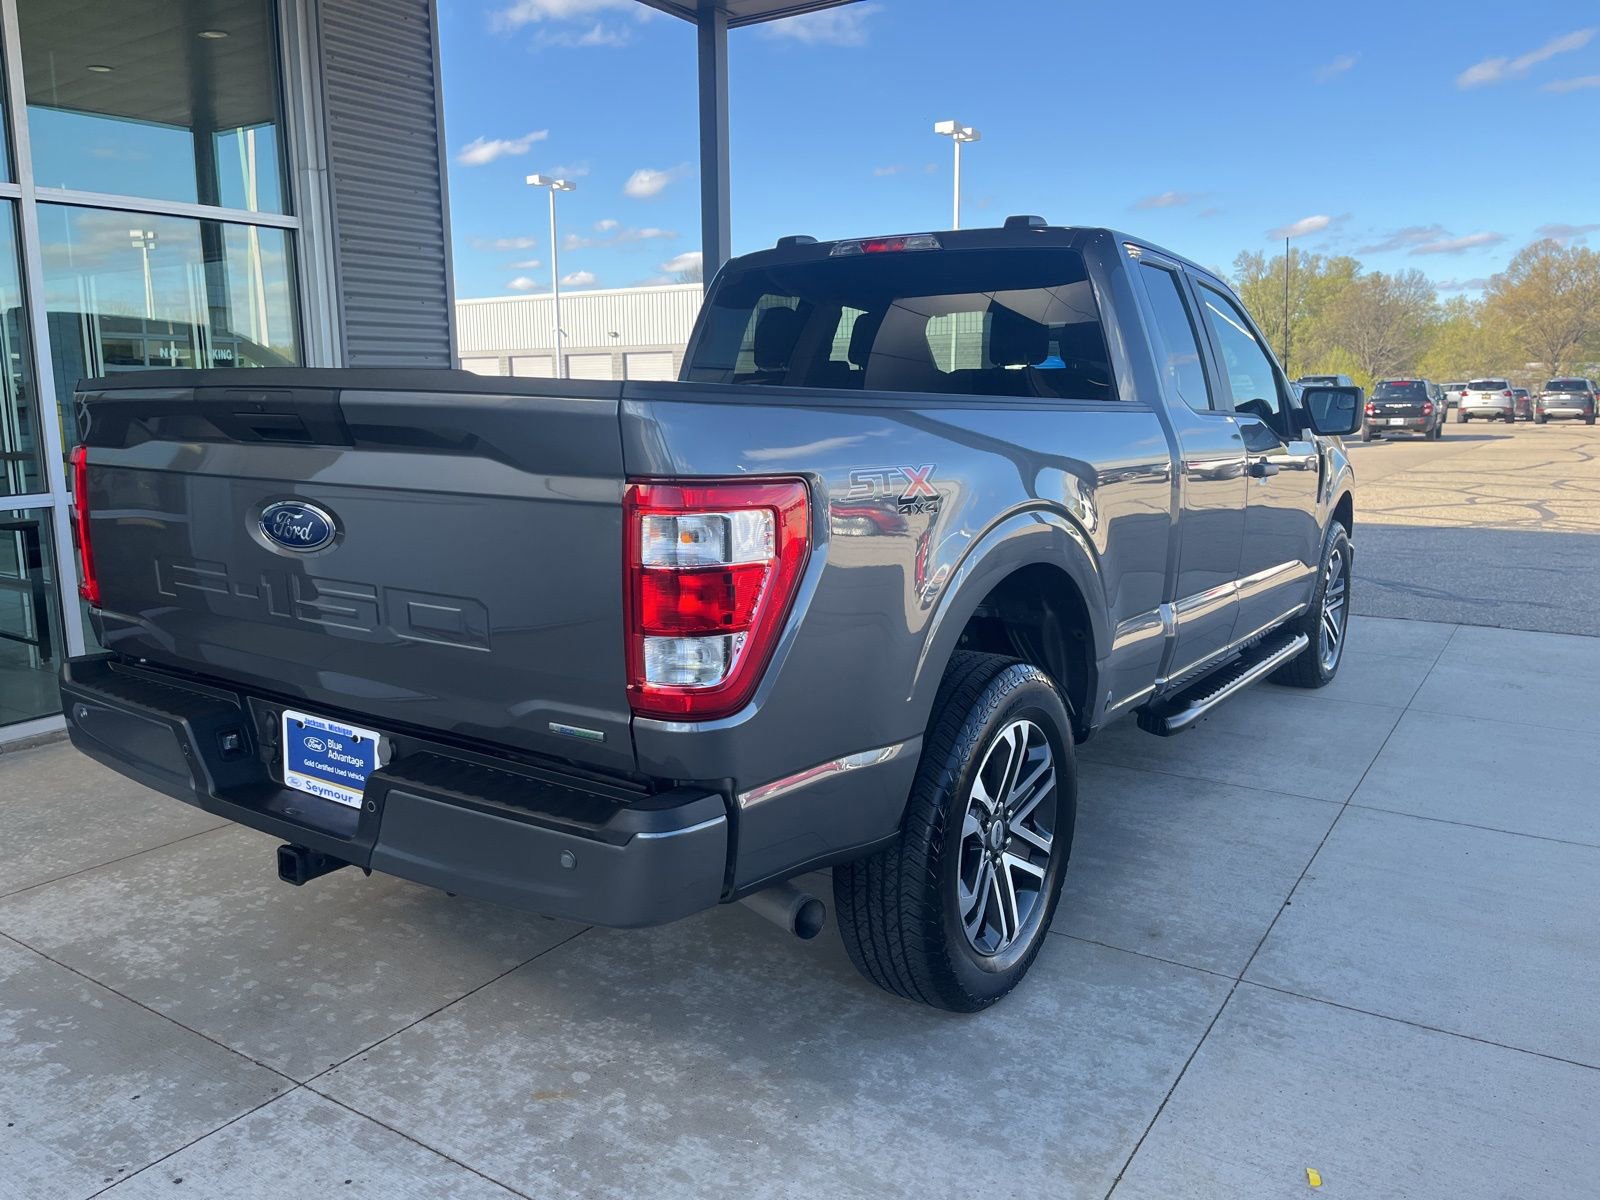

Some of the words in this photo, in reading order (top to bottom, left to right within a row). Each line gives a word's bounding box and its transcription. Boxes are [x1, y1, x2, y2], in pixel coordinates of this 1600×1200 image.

[160, 347, 179, 358] NO
[846, 464, 939, 501] STX
[273, 511, 314, 542] Ford
[153, 556, 492, 652] F-150
[328, 723, 353, 736] Michigan
[327, 739, 343, 751] Blue
[327, 750, 364, 768] Advantage
[303, 759, 315, 767] Gold
[315, 761, 335, 773] Certified
[334, 767, 347, 777] Used
[347, 771, 365, 782] Vehicle
[305, 781, 354, 803] Seymour
